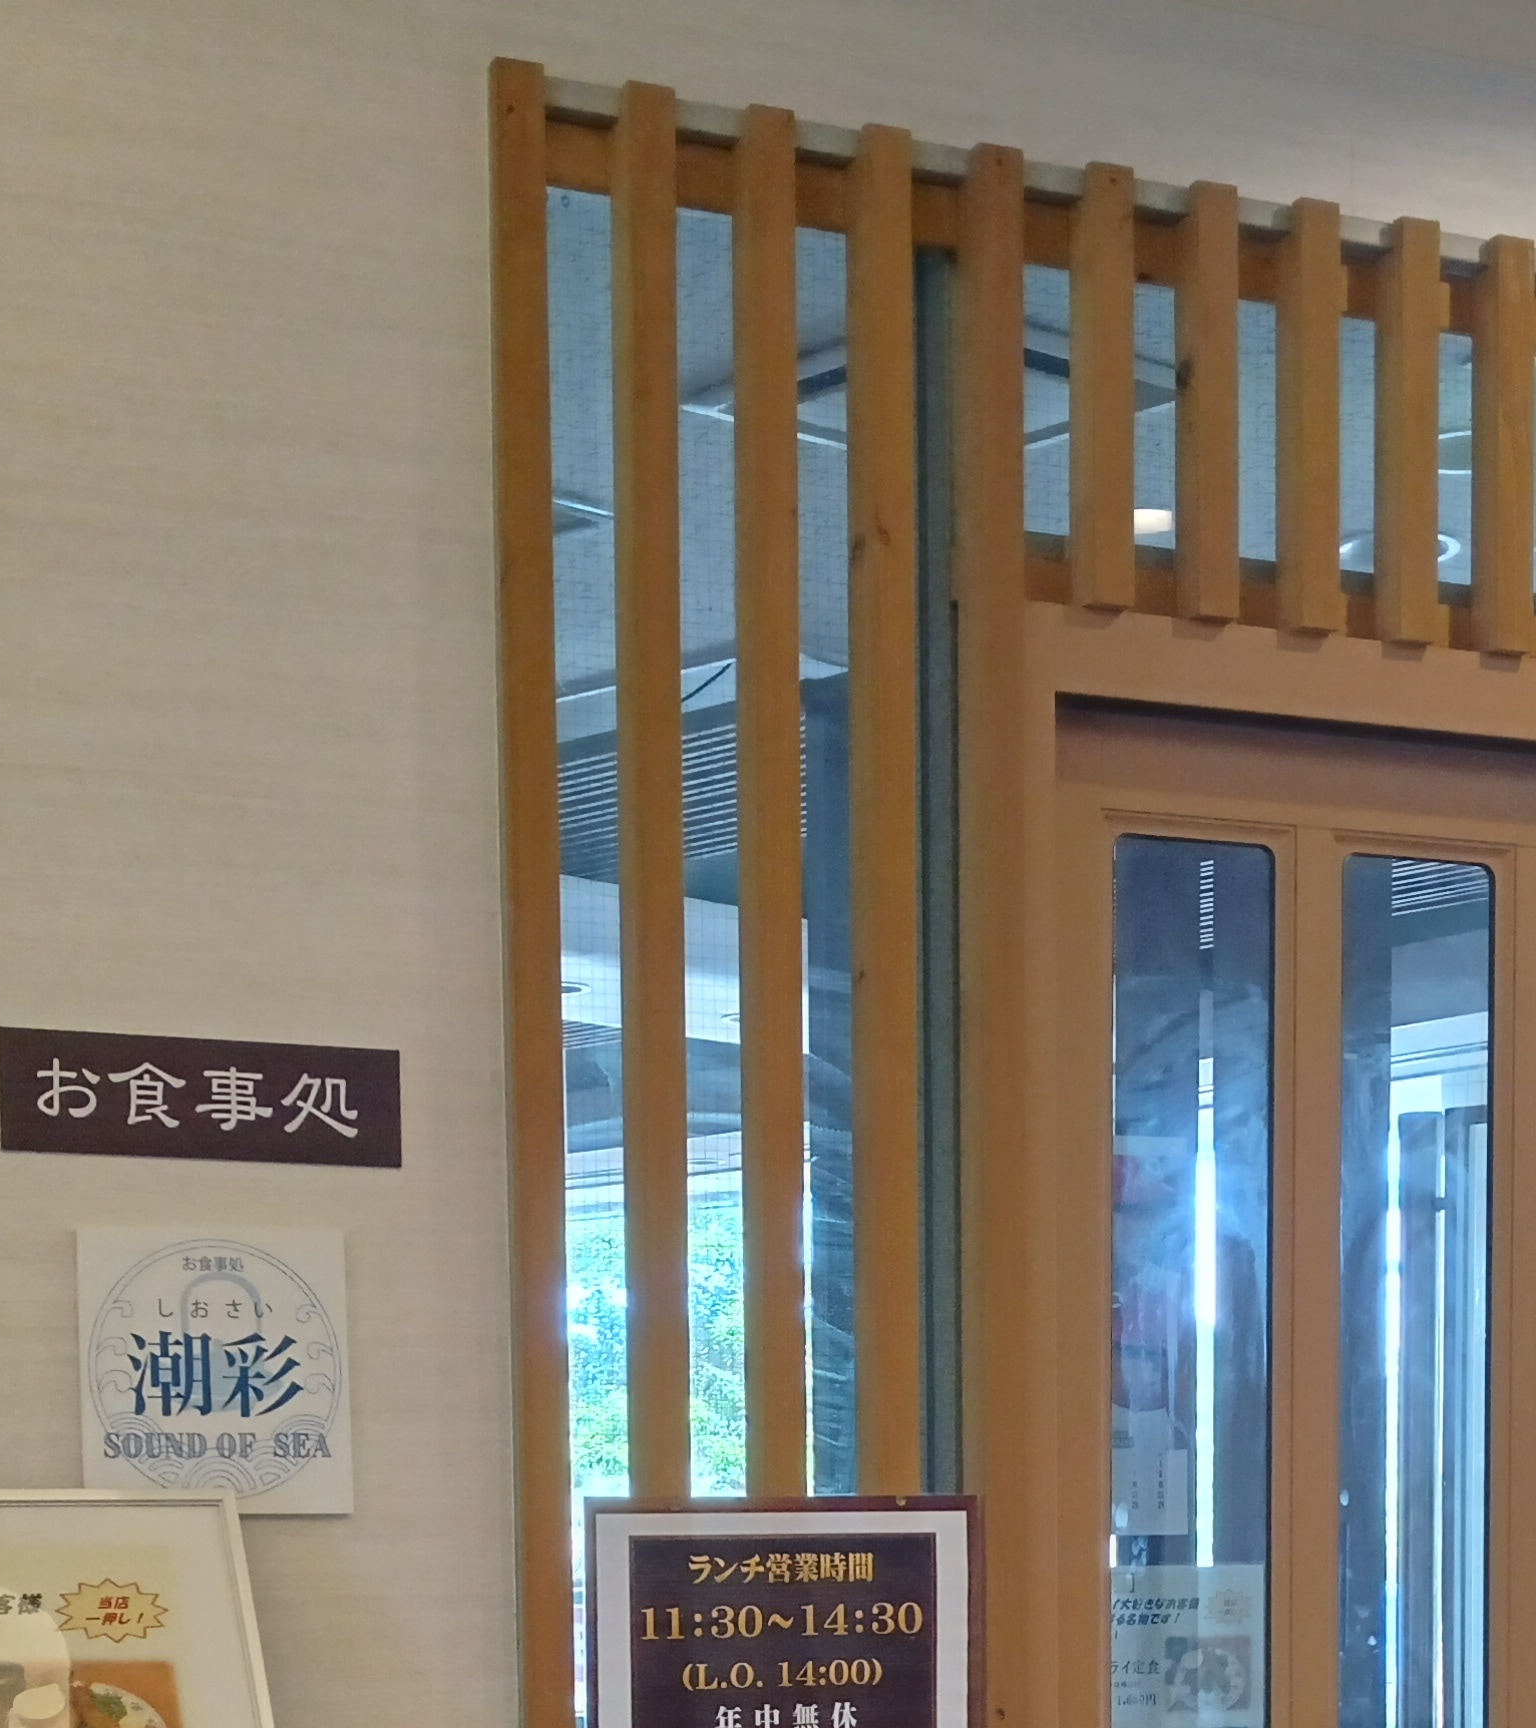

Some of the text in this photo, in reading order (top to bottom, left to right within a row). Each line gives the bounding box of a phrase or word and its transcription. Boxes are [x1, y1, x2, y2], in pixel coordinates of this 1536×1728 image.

[36, 1058, 359, 1138] お食事処
[182, 1255, 245, 1273] お食事処
[157, 1299, 274, 1320] しおさい
[127, 1331, 304, 1417] 潮彩
[104, 1432, 332, 1459] SOUND OF SEA
[687, 1552, 874, 1584] ランチ営業時間
[98, 1596, 130, 1609] 当店
[681, 1657, 884, 1691] (L.O. 14:00)
